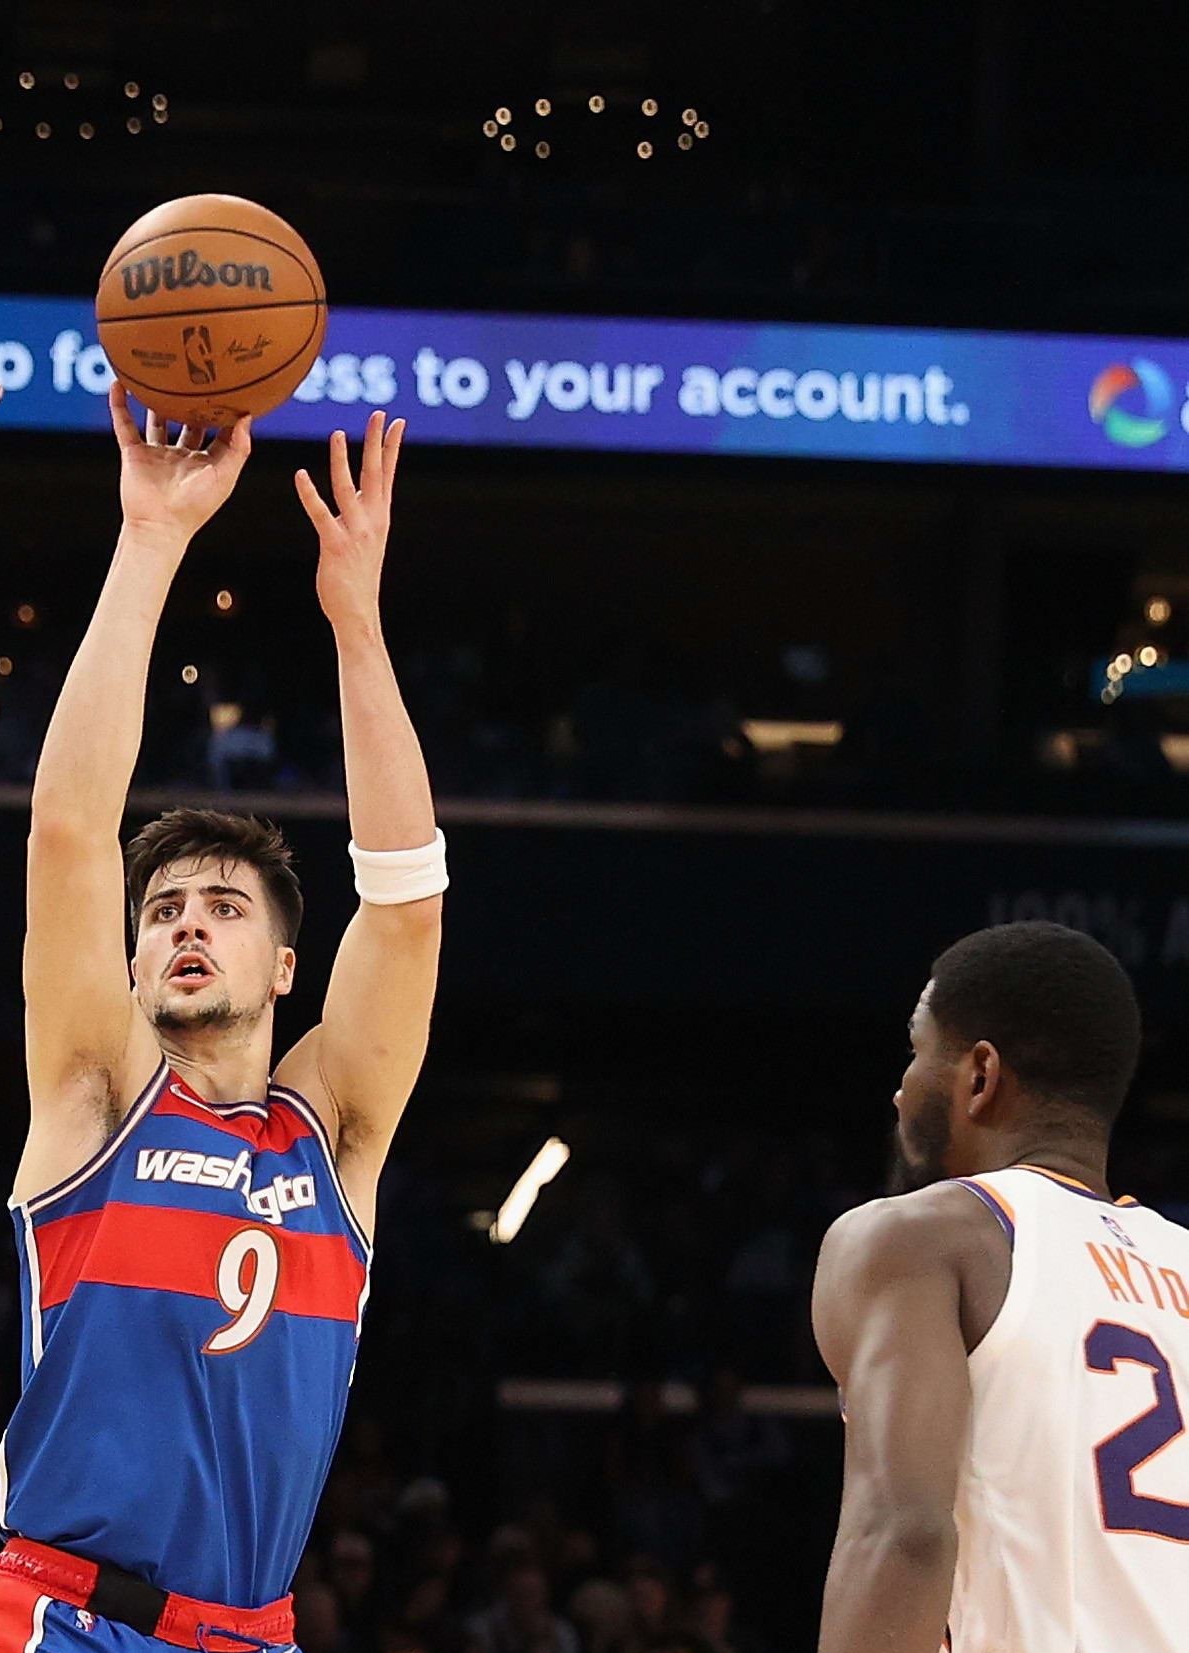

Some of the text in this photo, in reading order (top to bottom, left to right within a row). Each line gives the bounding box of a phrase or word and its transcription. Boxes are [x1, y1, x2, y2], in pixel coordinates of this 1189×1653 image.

[121, 249, 273, 300] Wilson
[50, 329, 119, 395] fo
[292, 353, 398, 405] ess
[412, 346, 489, 408] to
[504, 359, 664, 421] your
[678, 366, 970, 426] account.
[135, 1149, 317, 1226] washgto
[200, 1223, 282, 1355] 9
